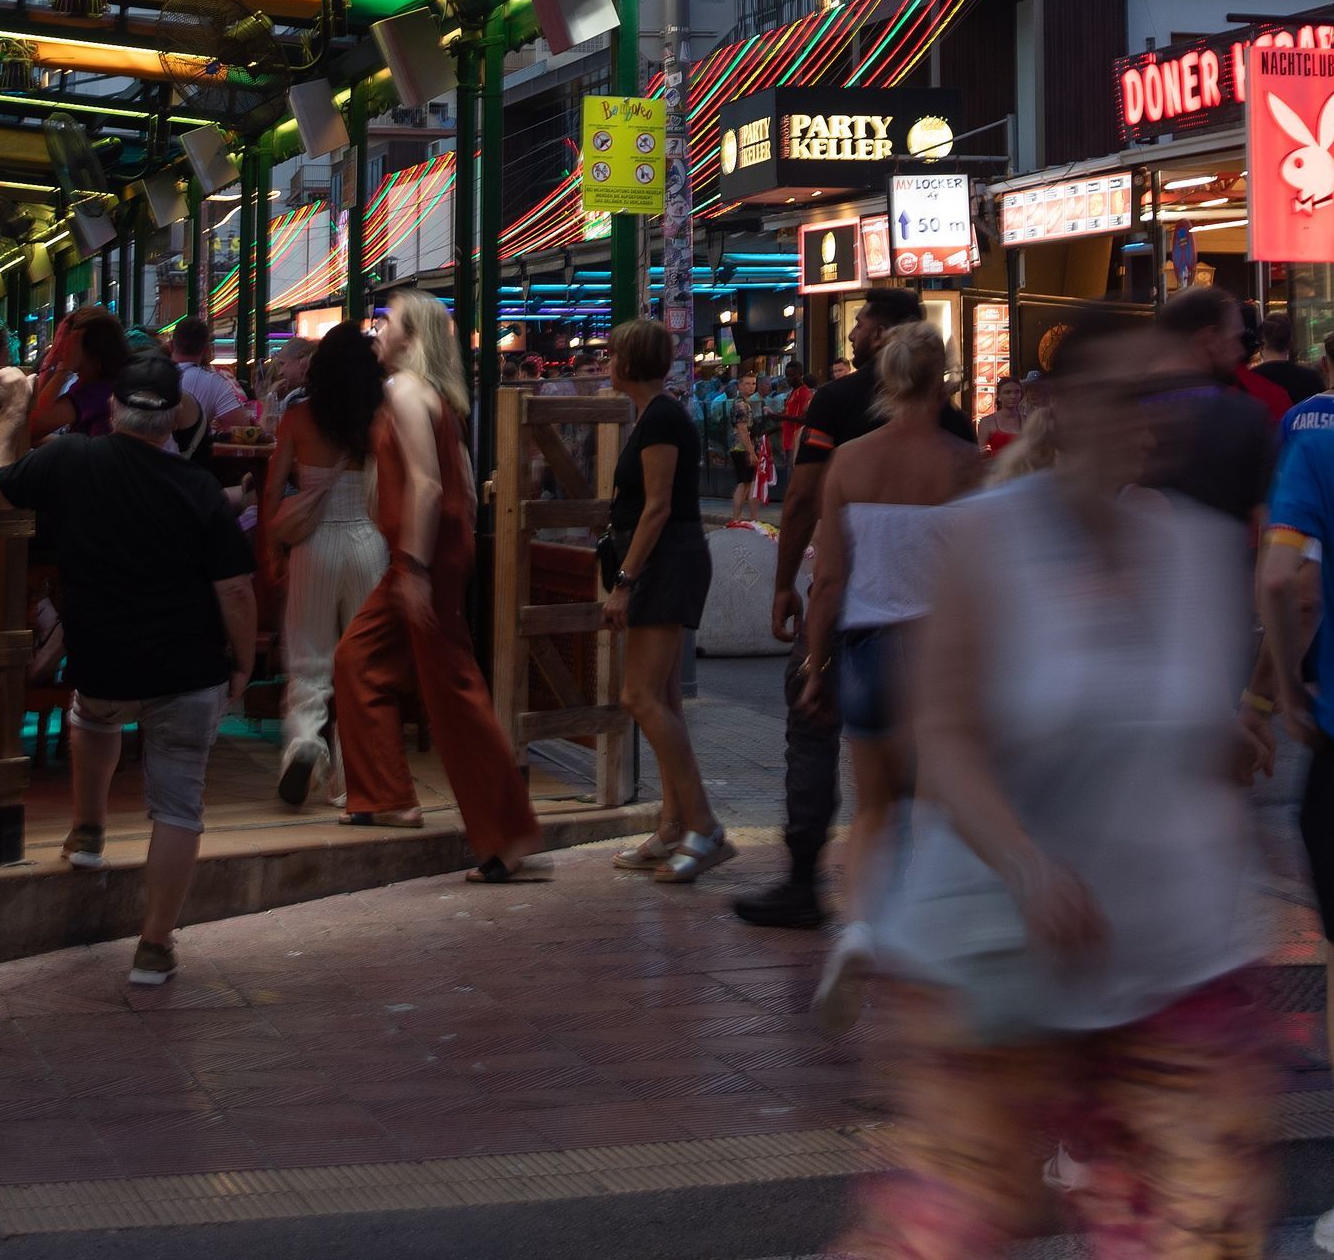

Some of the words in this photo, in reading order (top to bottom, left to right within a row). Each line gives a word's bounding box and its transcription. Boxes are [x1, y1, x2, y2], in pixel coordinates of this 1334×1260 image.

[1261, 51, 1334, 77] NACHTCLUB
[1122, 49, 1221, 126] DÖNER
[742, 117, 771, 148] PARTY
[789, 114, 893, 139] PARTY
[742, 140, 772, 167] KELLER
[788, 138, 893, 161] KELLER
[895, 179, 914, 190] MY
[915, 178, 963, 190] LOCKER
[918, 217, 941, 233] 50
[949, 220, 966, 232] m
